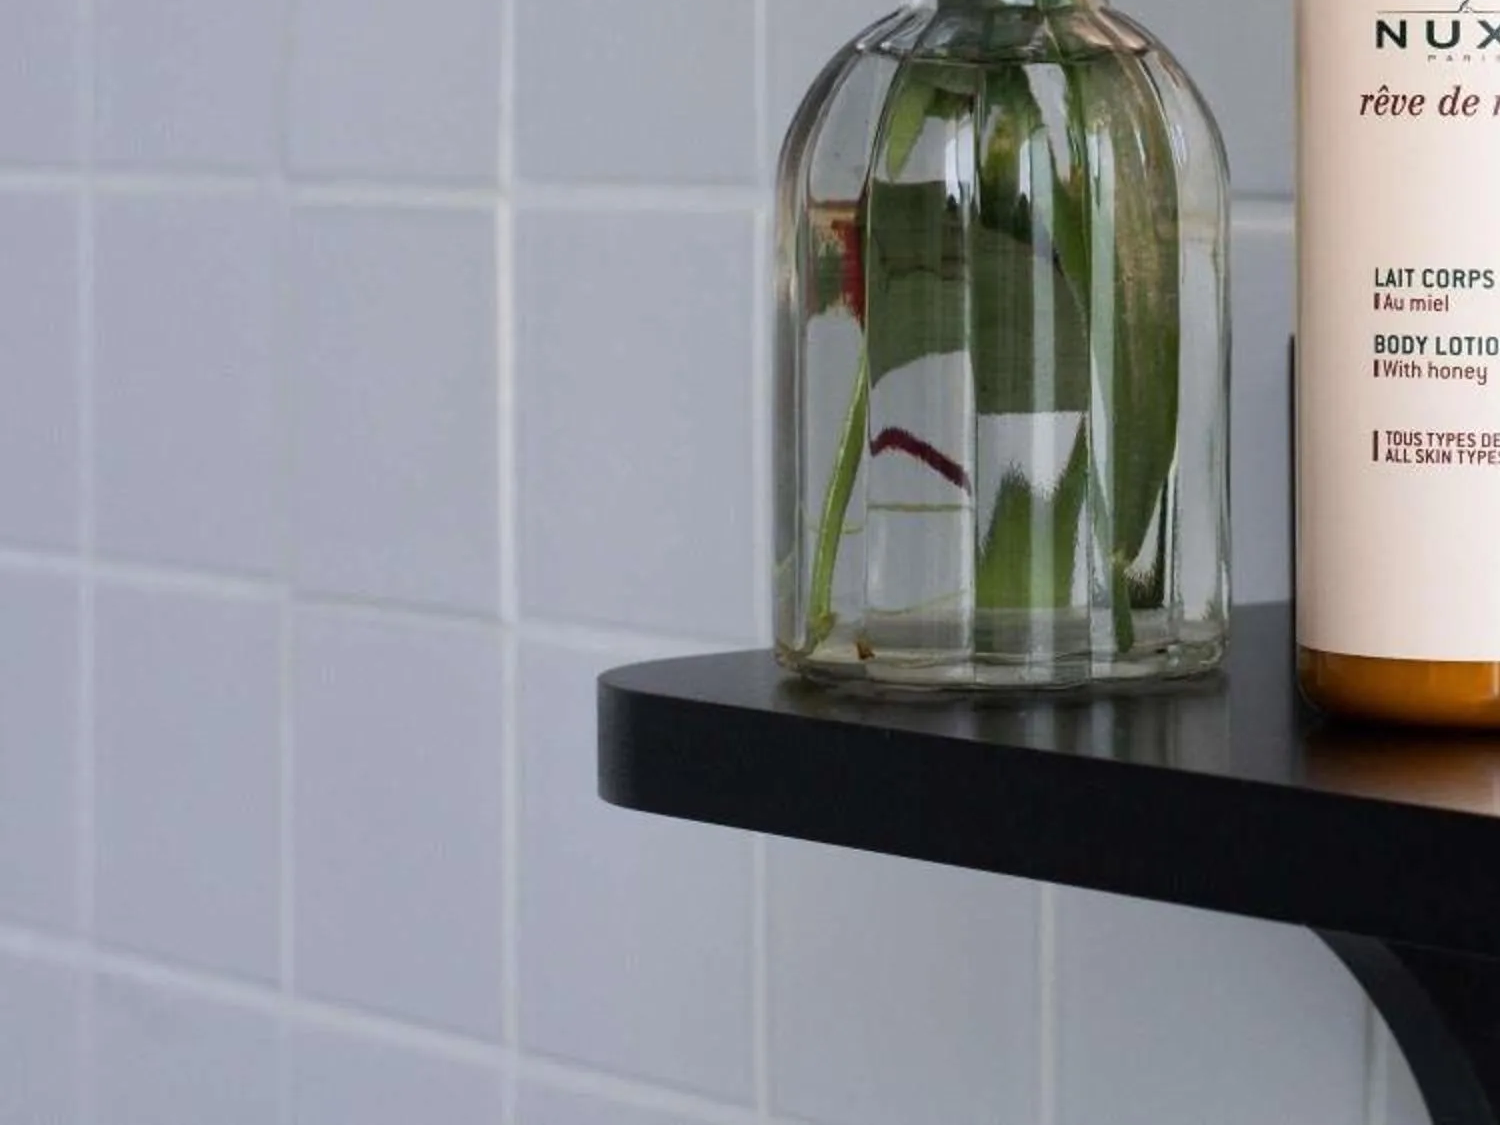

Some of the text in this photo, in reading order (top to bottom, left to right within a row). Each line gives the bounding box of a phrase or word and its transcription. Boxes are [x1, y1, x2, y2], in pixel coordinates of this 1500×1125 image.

[1360, 84, 1426, 118] rêve
[1438, 85, 1480, 117] de
[1375, 267, 1495, 289] LAIT CORPS
[1383, 293, 1449, 312] Au miel
[1374, 334, 1428, 355] BODY
[1383, 359, 1487, 385] With honey
[1385, 429, 1423, 447] TOUS
[1426, 431, 1476, 448] TYPES
[1385, 449, 1412, 463] ALL
[1415, 449, 1452, 464] SKIN
